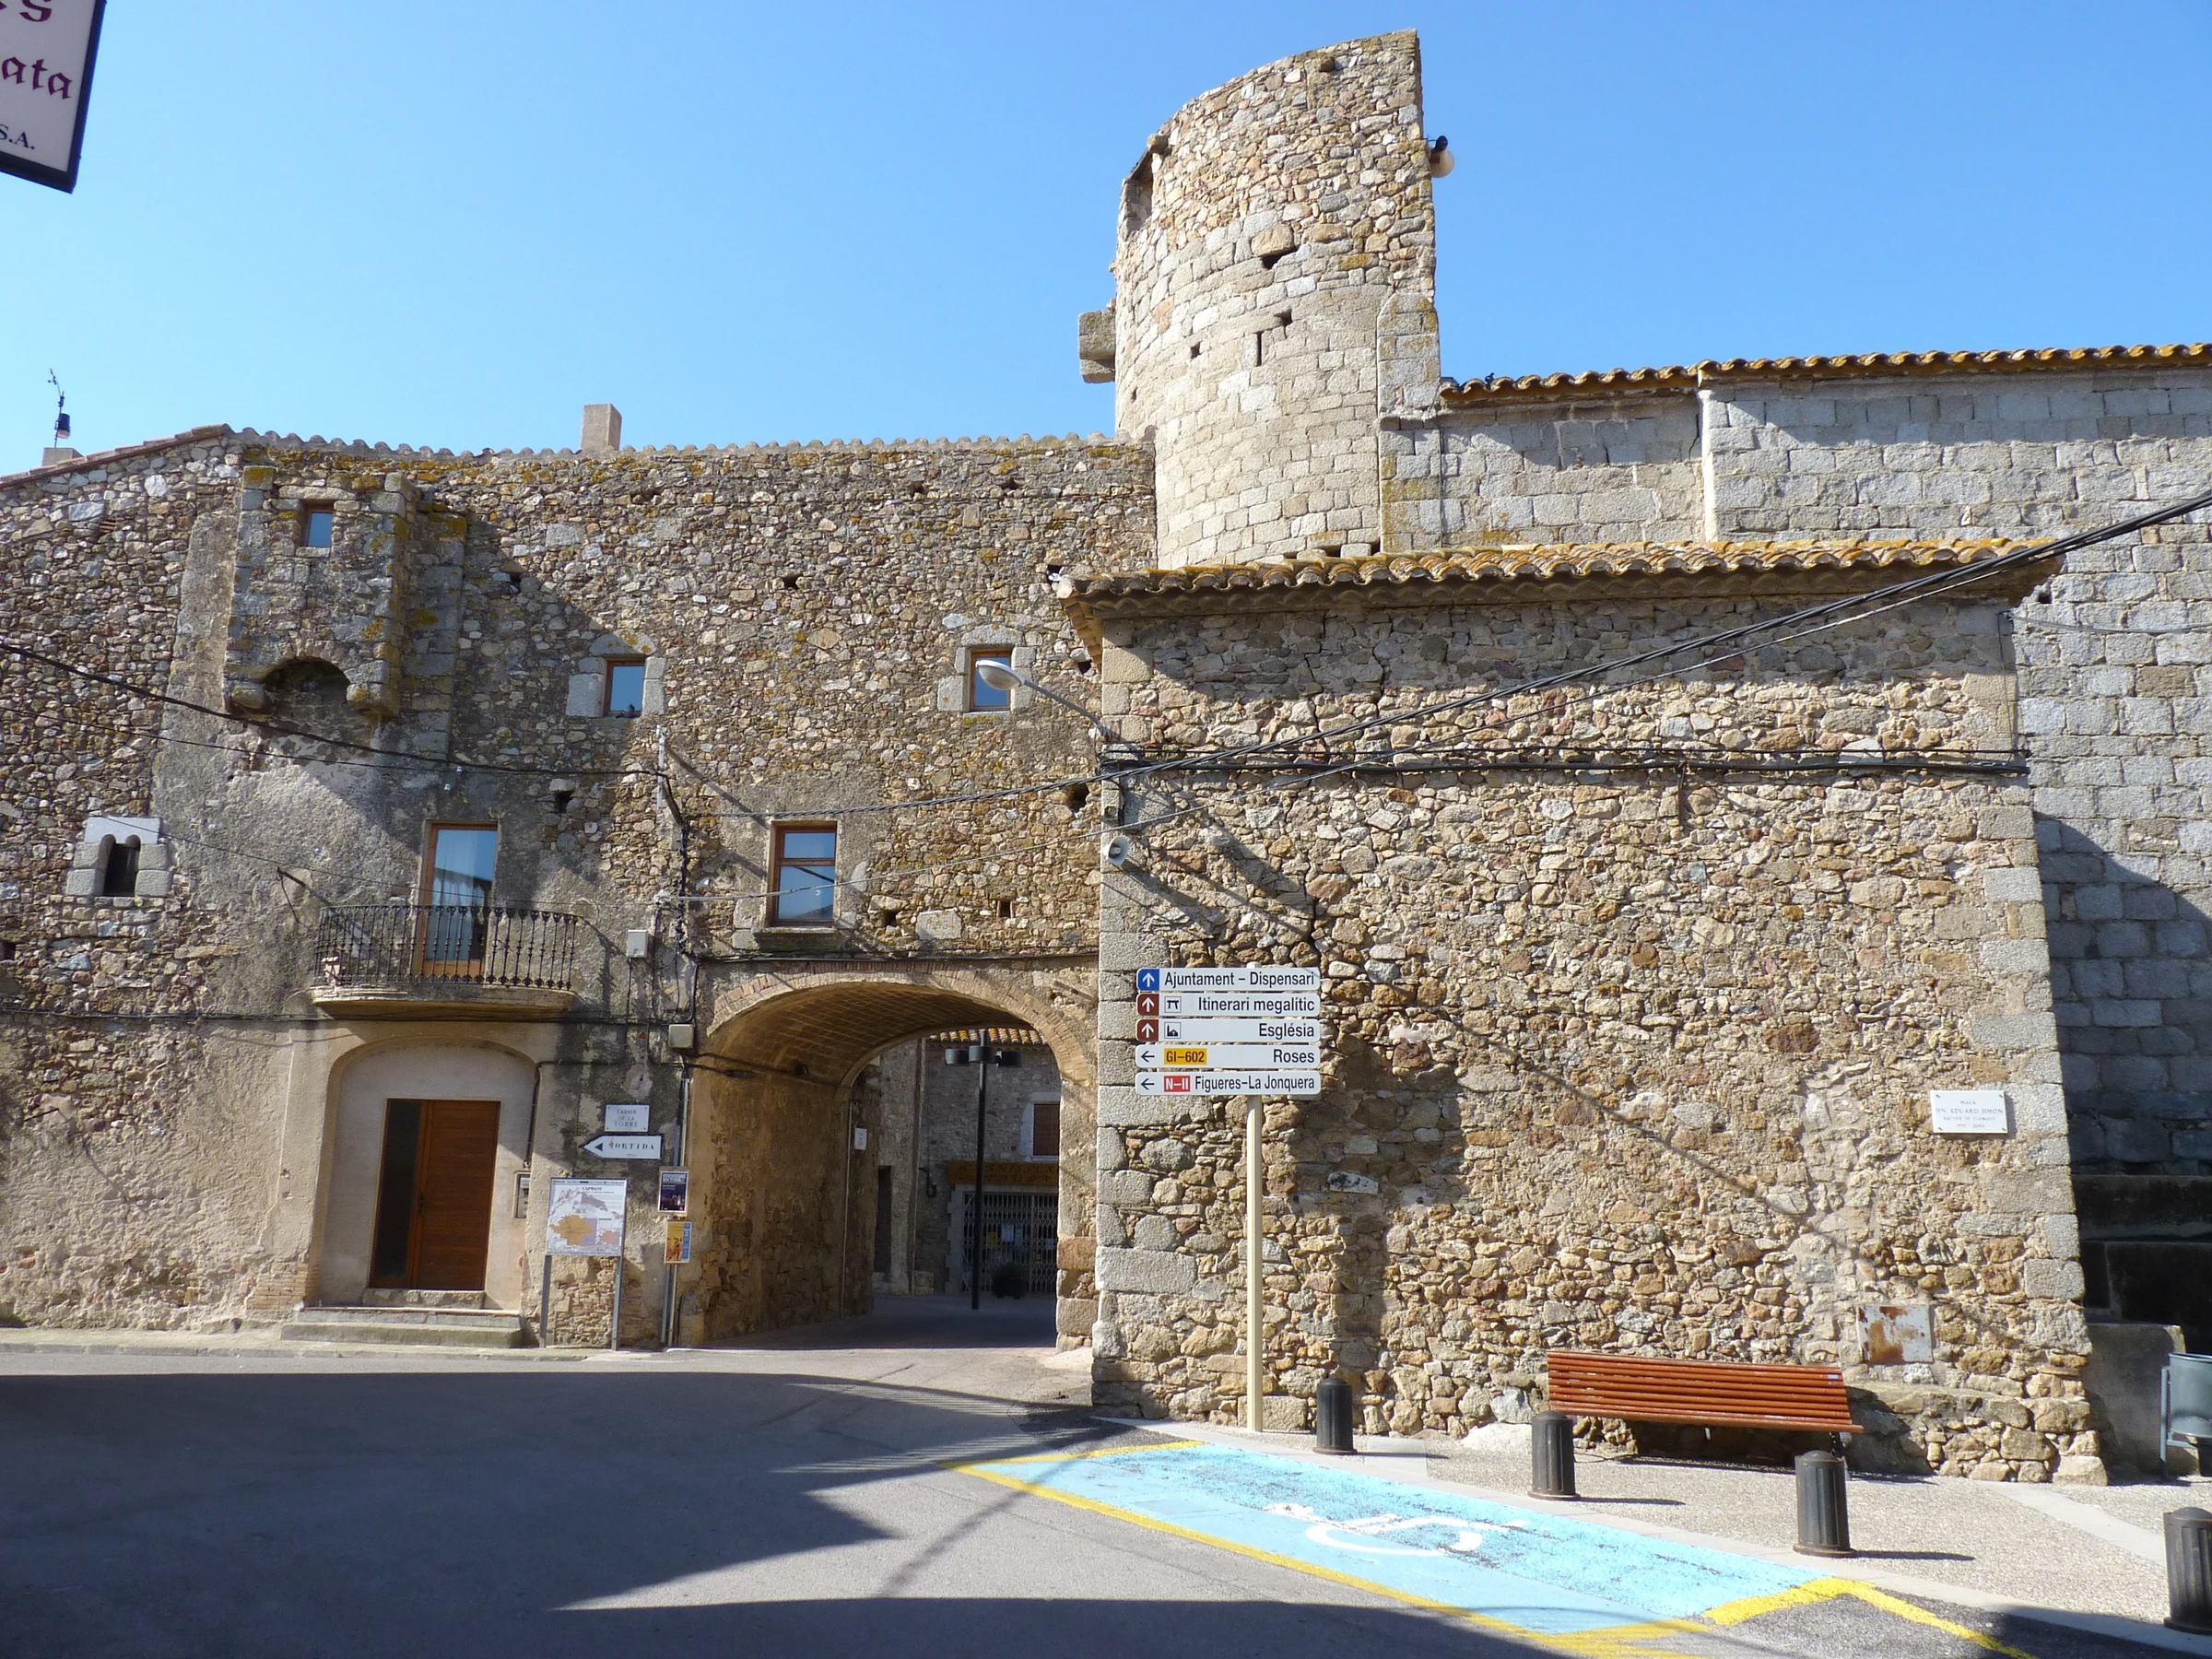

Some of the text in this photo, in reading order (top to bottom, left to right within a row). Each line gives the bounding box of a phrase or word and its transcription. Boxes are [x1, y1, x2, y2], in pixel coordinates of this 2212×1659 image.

[1164, 971, 1235, 987] Ajuntament
[1250, 971, 1315, 988] Dispensari
[1198, 996, 1315, 1014] Itinerari megalític
[1258, 1022, 1314, 1040] Església
[1166, 1051, 1205, 1063] GI-602
[1273, 1049, 1315, 1064] Roses
[1165, 1077, 1189, 1090] N-II
[1265, 1076, 1315, 1092] Jonquera
